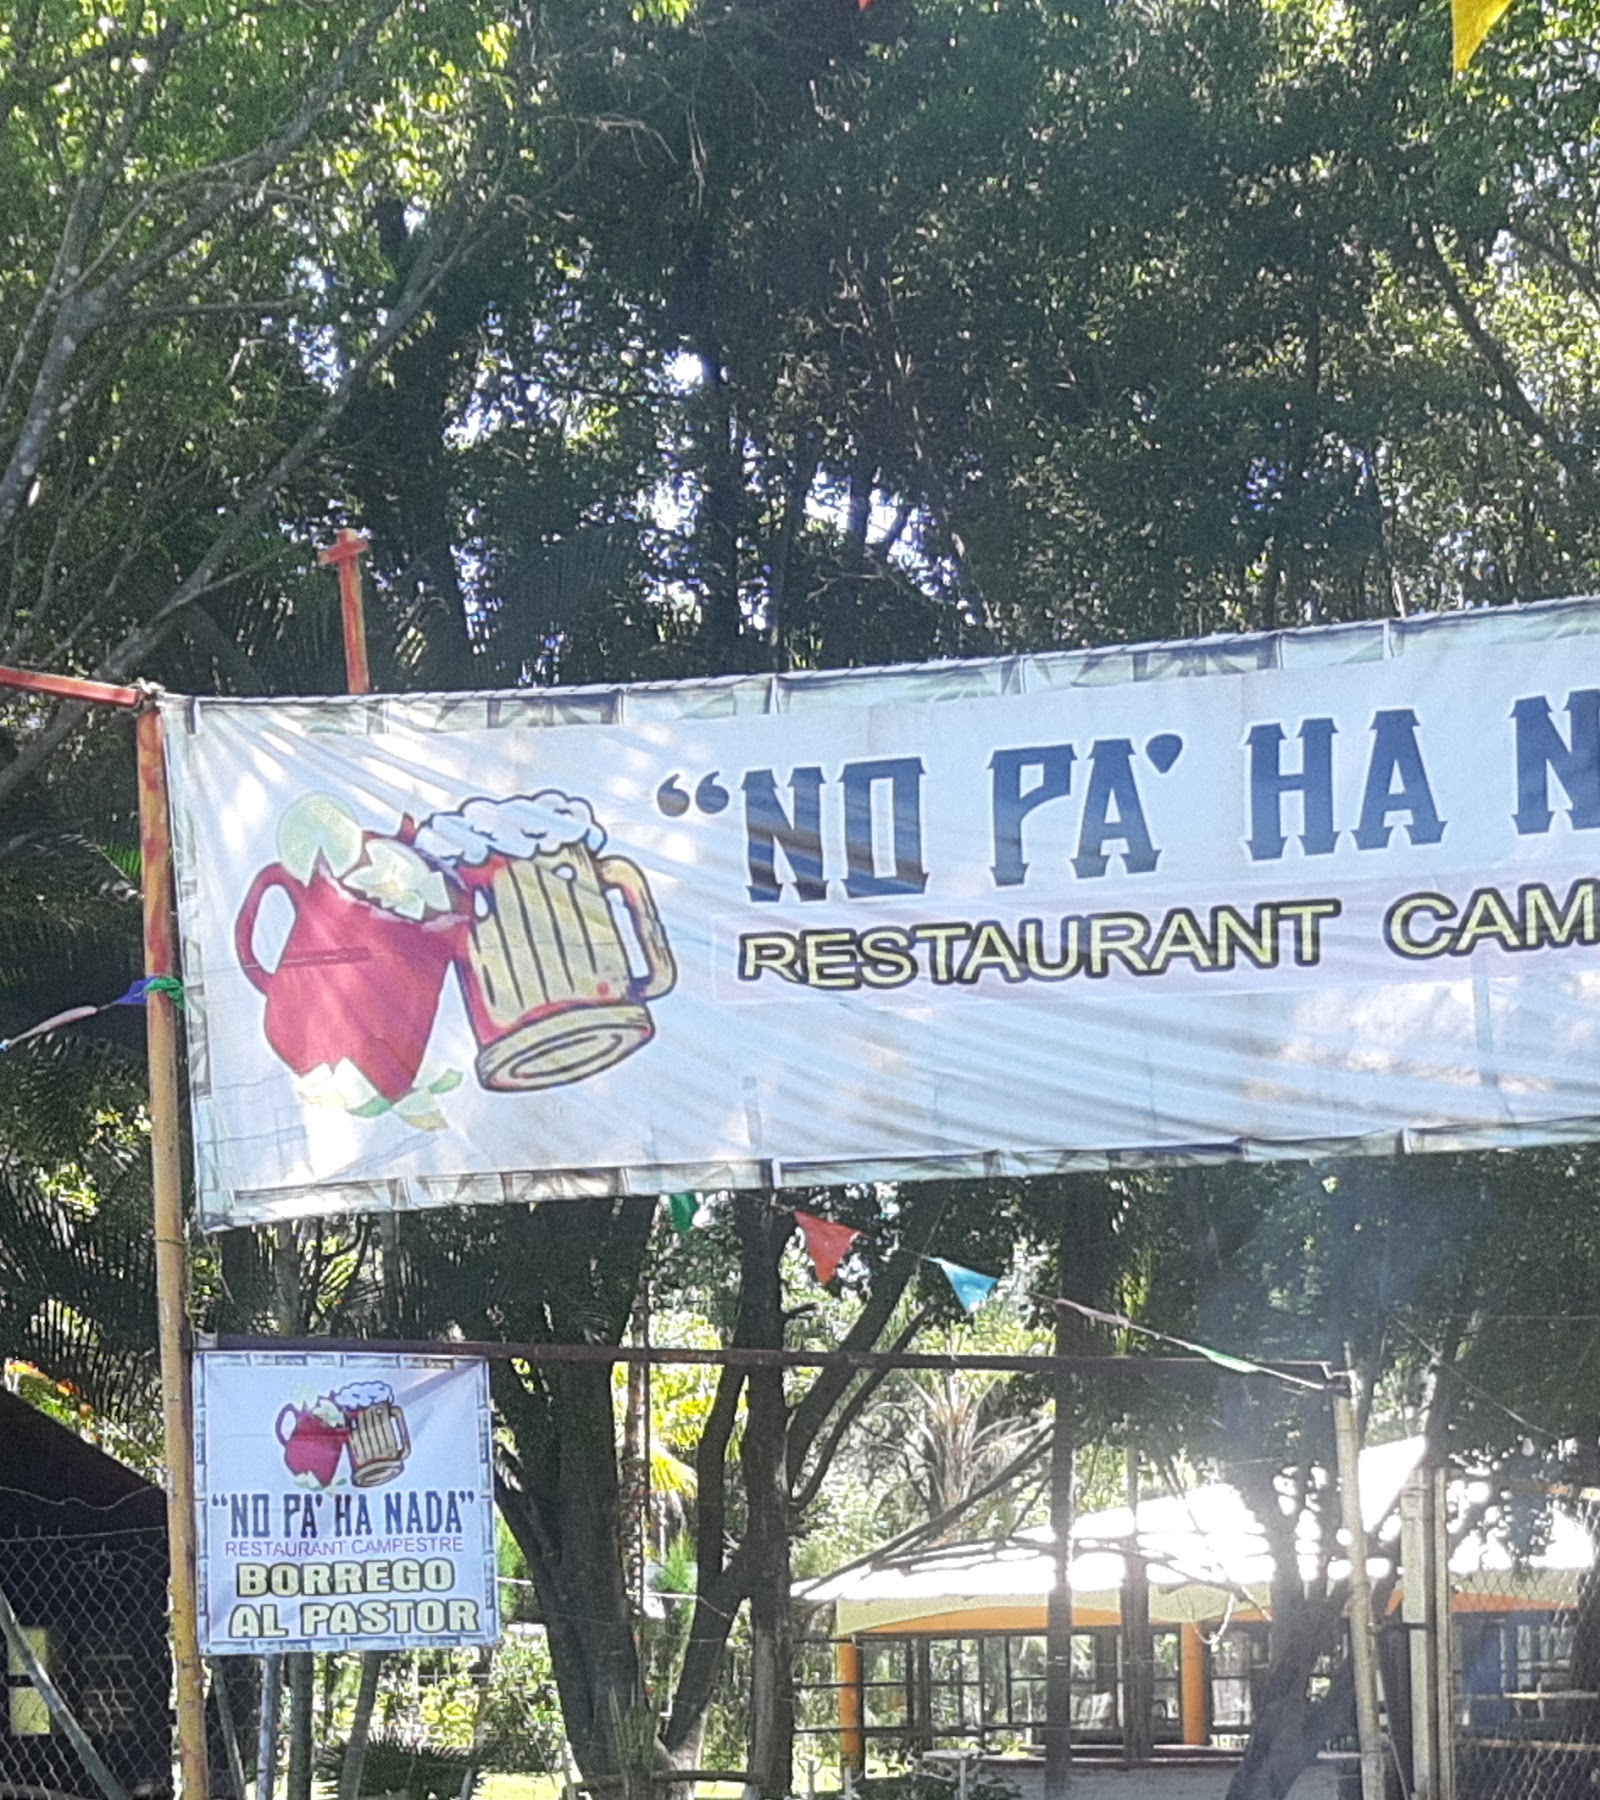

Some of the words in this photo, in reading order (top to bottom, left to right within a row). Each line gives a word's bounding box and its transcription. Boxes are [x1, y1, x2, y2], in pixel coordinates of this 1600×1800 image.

[1244, 707, 1448, 861] HA
[739, 898, 1341, 988] RESTAURANT
[334, 1493, 372, 1538] HA
[225, 1540, 346, 1557] RESTAURANT
[351, 1537, 464, 1553] CAMPESTRE
[237, 1558, 455, 1597] BORREGO
[229, 1604, 288, 1638] AL
[301, 1599, 481, 1635] PASTOR
